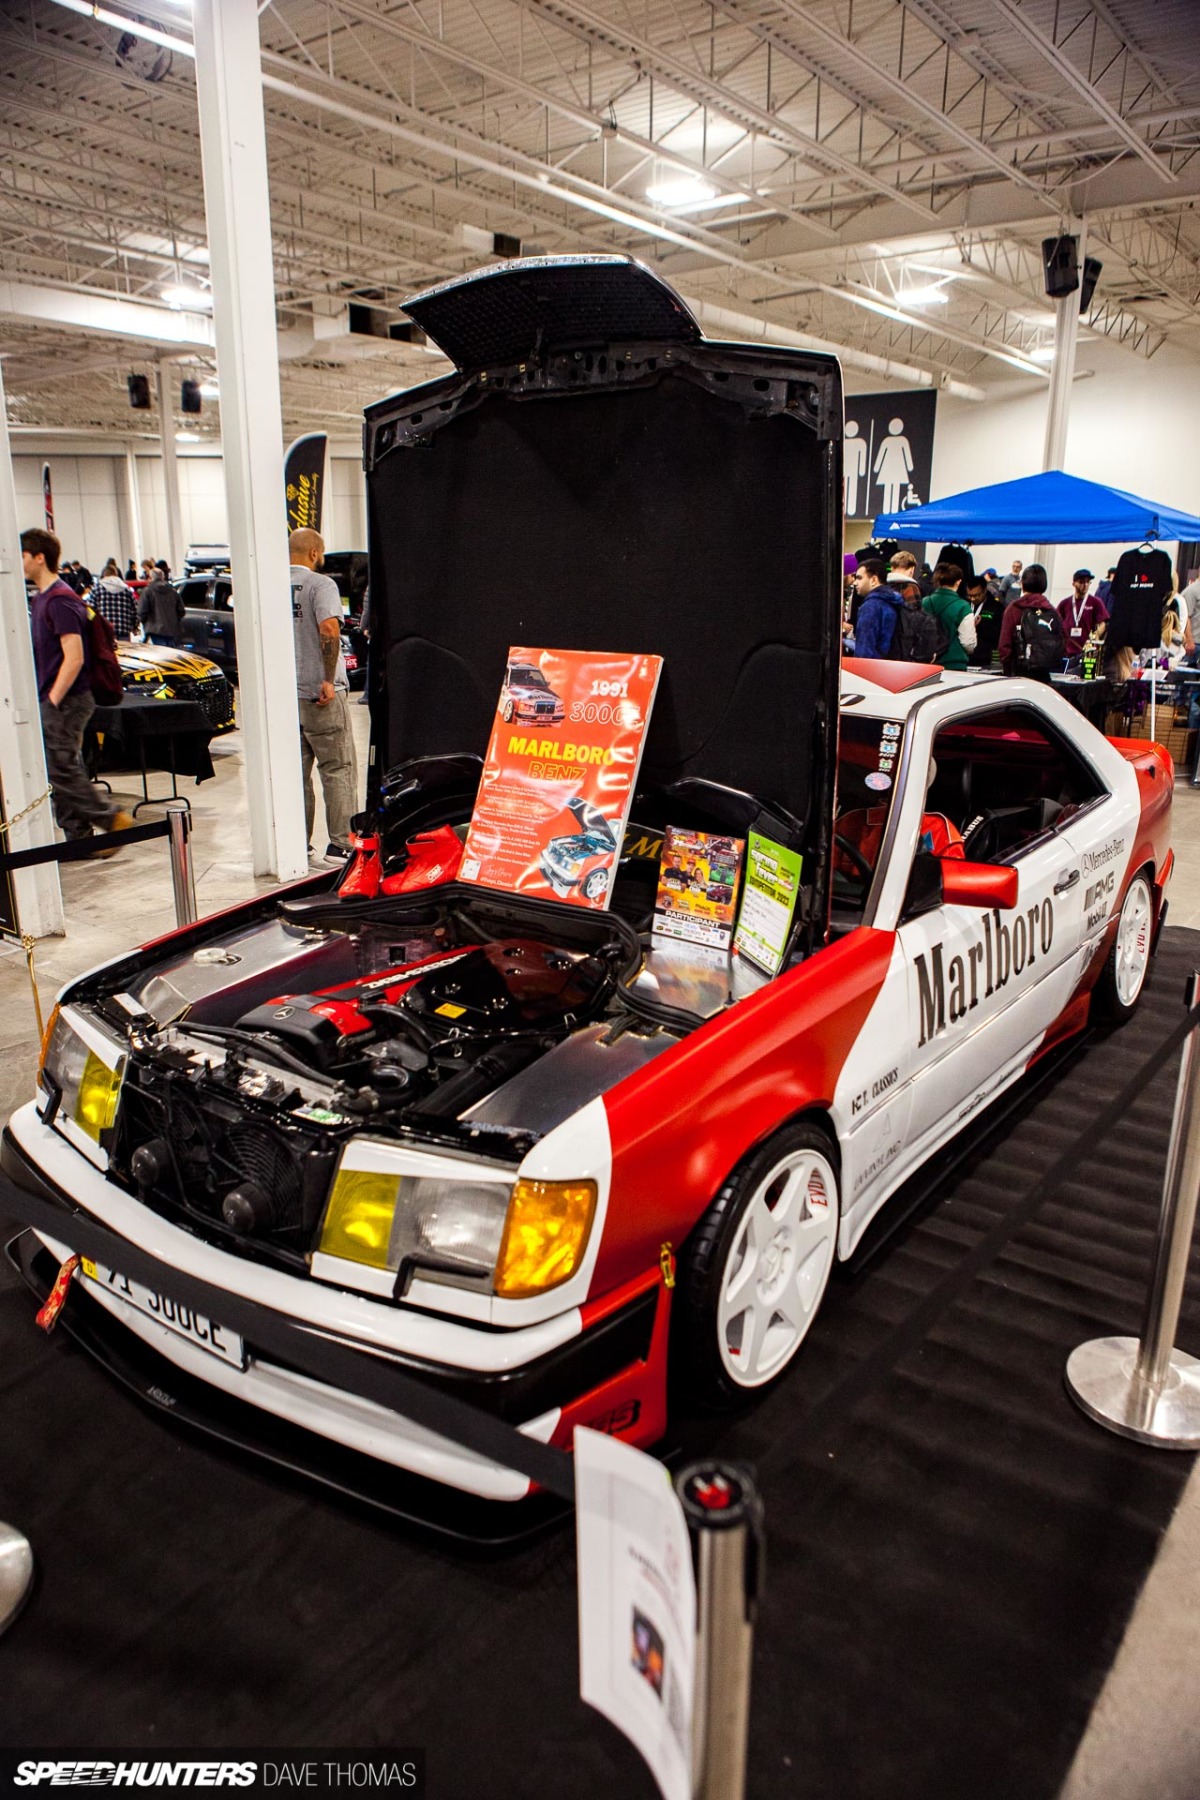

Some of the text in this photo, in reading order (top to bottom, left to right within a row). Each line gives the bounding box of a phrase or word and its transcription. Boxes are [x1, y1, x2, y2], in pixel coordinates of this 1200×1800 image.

[590, 680, 629, 698] 1991
[528, 761, 587, 782] BENZ
[665, 910, 721, 929] PARTICIPANT
[913, 896, 1053, 1049] Marlboro
